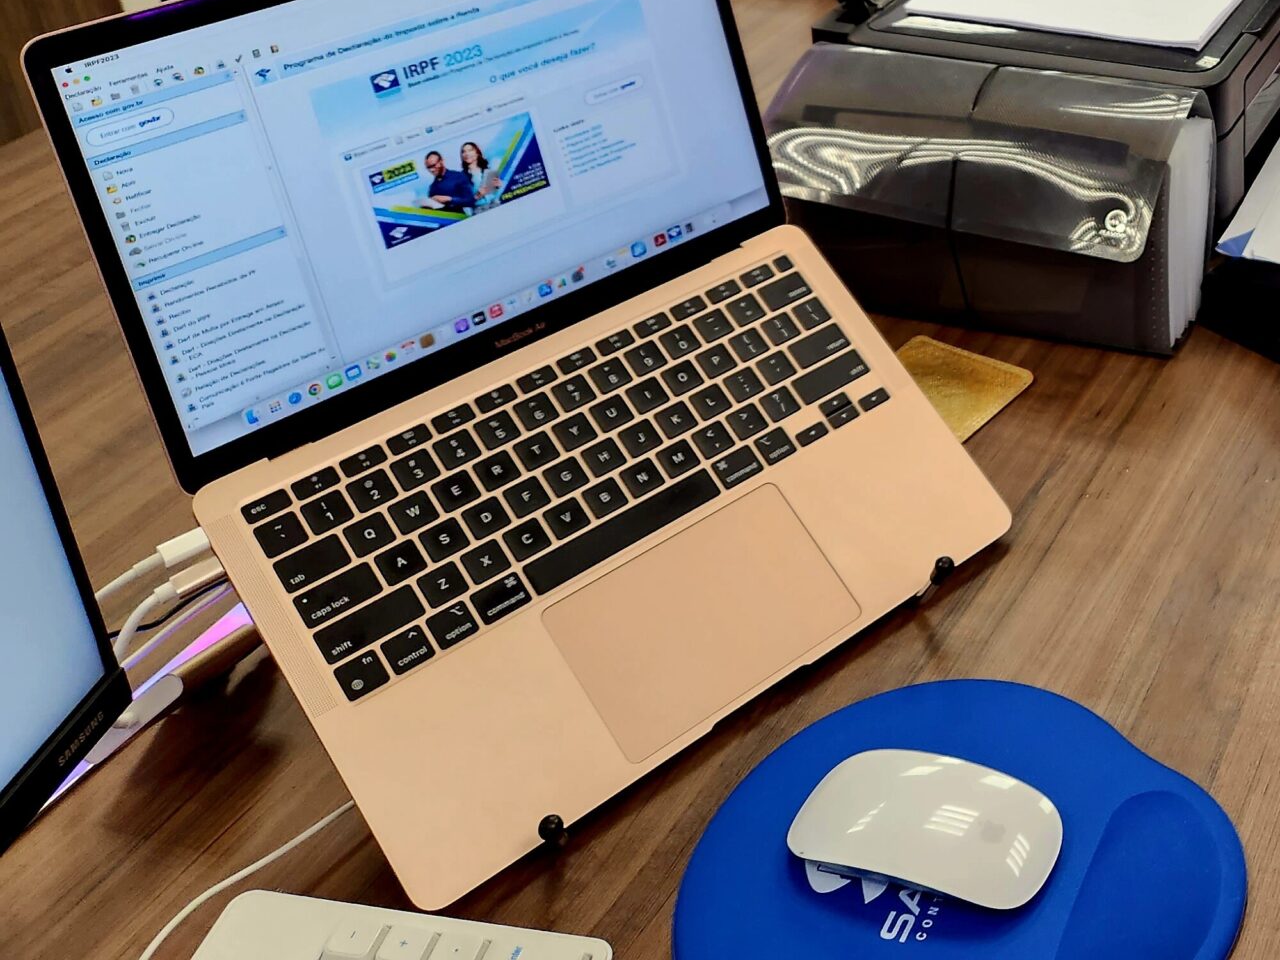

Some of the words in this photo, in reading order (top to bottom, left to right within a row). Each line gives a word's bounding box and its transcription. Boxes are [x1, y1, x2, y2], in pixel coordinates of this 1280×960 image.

[284, 55, 324, 71] Programa
[338, 37, 381, 54] Declaração
[395, 23, 426, 37] Imposto
[428, 16, 448, 27] sobre
[456, 7, 480, 17] Renda
[84, 54, 119, 68] IRPF2023
[403, 57, 440, 79] IRPF
[444, 44, 483, 66] 2023
[490, 75, 497, 83] O
[500, 71, 516, 82] que
[518, 61, 538, 74] você
[540, 52, 569, 68] deseja
[570, 42, 596, 57] fazer?
[65, 85, 102, 100] Declaração
[109, 72, 148, 87] Ferramentas
[156, 64, 174, 74] Ajuda
[78, 112, 104, 123] Acesso
[94, 150, 131, 166] Declaração
[116, 167, 133, 175] Nova
[139, 225, 165, 238] Entregar
[167, 214, 201, 230] Declaração
[160, 280, 194, 295] Declaração
[495, 328, 534, 348] MacBook
[711, 355, 721, 365] P
[677, 372, 688, 382] O
[706, 399, 716, 407] L
[534, 410, 545, 420] 6
[606, 407, 618, 418] U
[670, 414, 682, 425] K
[495, 429, 507, 439] 5
[569, 425, 580, 436] Y
[638, 432, 646, 443] J
[456, 448, 466, 458] 4
[530, 444, 541, 455] T
[769, 444, 790, 460] option
[597, 450, 611, 462] H
[672, 452, 685, 464] M
[413, 469, 424, 478] 3
[491, 465, 503, 476] R
[560, 471, 572, 481] G
[726, 462, 758, 483] command
[636, 472, 649, 483] N
[370, 490, 381, 500] 2
[451, 485, 462, 496] E
[521, 491, 532, 502] F
[599, 492, 611, 503] B
[251, 503, 267, 515] esc
[406, 505, 421, 518] W
[326, 512, 334, 521] 1
[480, 512, 493, 523] D
[560, 512, 572, 523] V
[364, 528, 376, 539] Q
[438, 533, 450, 544] S
[521, 533, 533, 544] C
[396, 557, 408, 568] A
[479, 555, 493, 567] X
[290, 573, 306, 585] tab
[437, 578, 450, 590] Z
[311, 605, 331, 620] caps
[331, 595, 351, 609] lock
[487, 591, 526, 617] command
[445, 621, 472, 640] option
[331, 640, 353, 656] shift
[362, 655, 373, 665] fn
[397, 646, 429, 667] control
[58, 712, 104, 766] SAMSUNG
